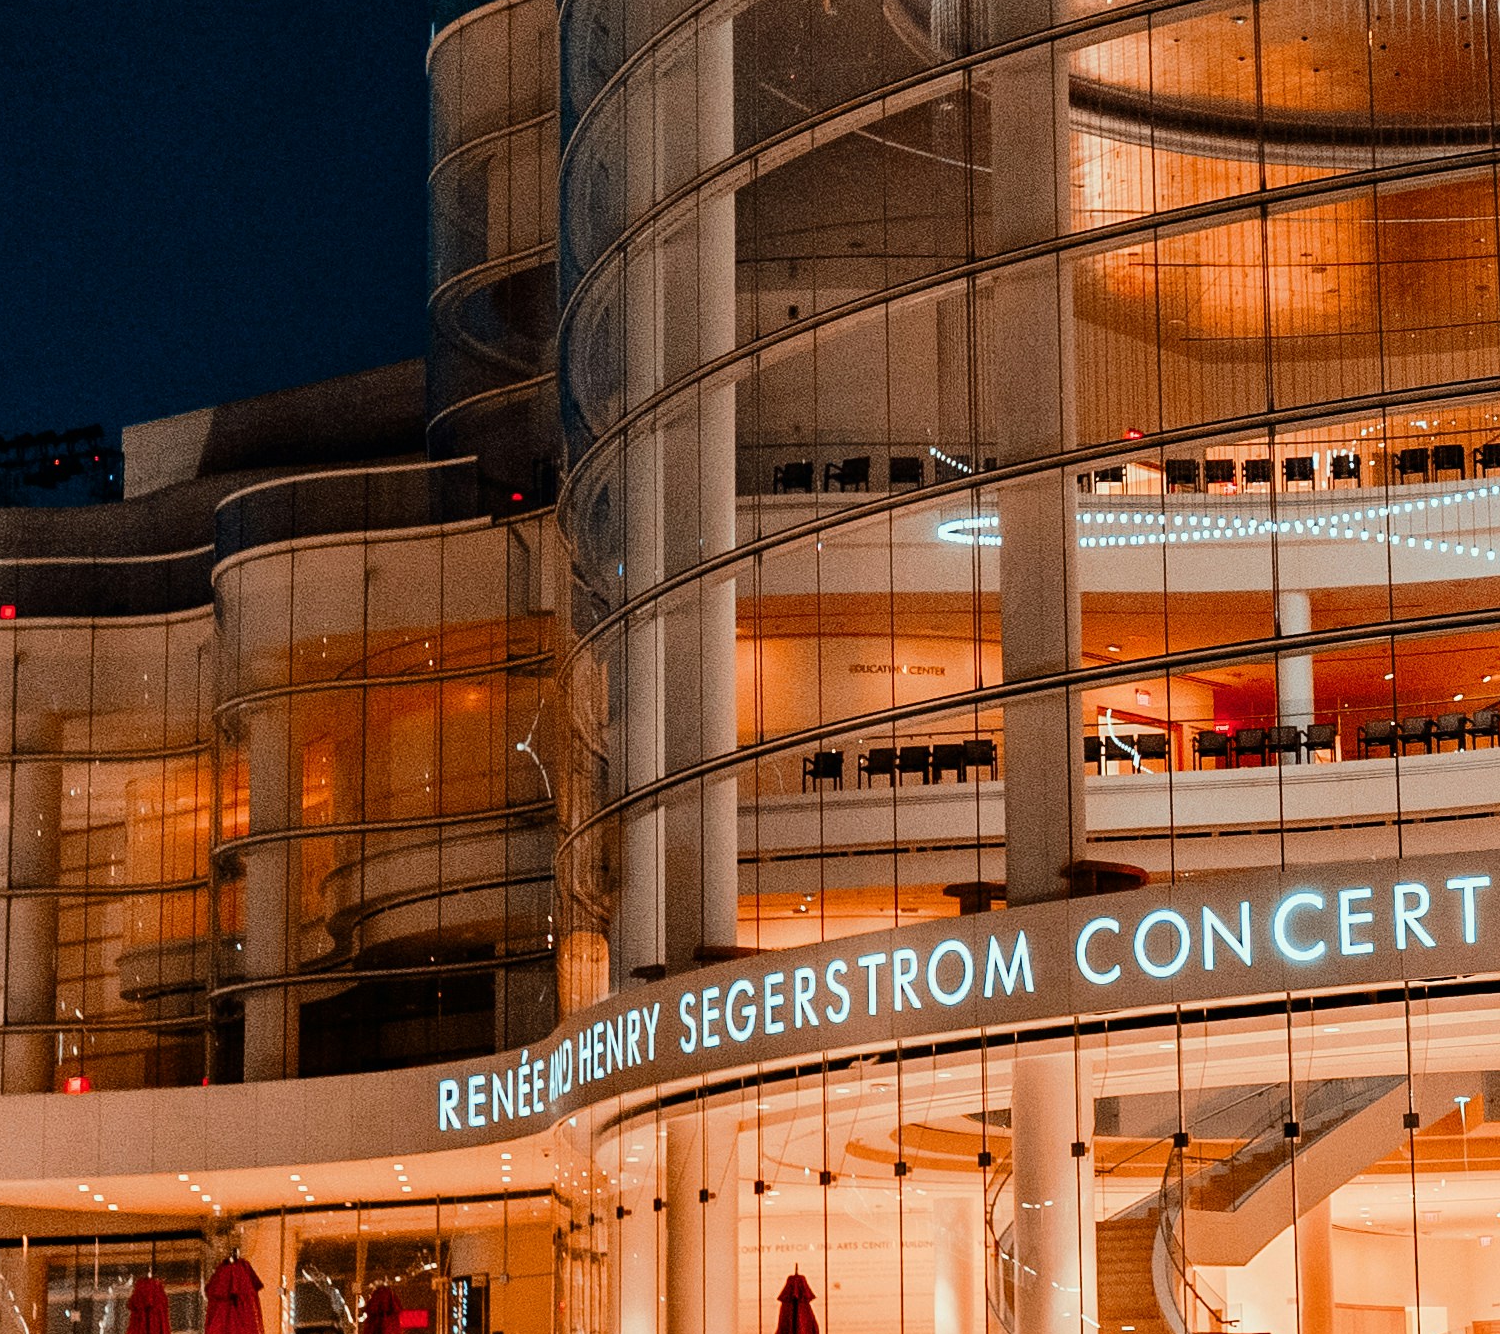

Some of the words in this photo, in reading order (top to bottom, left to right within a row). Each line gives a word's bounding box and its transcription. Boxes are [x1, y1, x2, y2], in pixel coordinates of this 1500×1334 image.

[909, 666, 946, 676] CENTER
[438, 1047, 546, 1133] RENÉE
[548, 1038, 573, 1104] AND
[578, 1002, 660, 1085] HENRY
[679, 929, 1035, 1054] SEGERSTROM
[1075, 875, 1491, 985] CONCERT
[836, 1241, 859, 1251] ARTS
